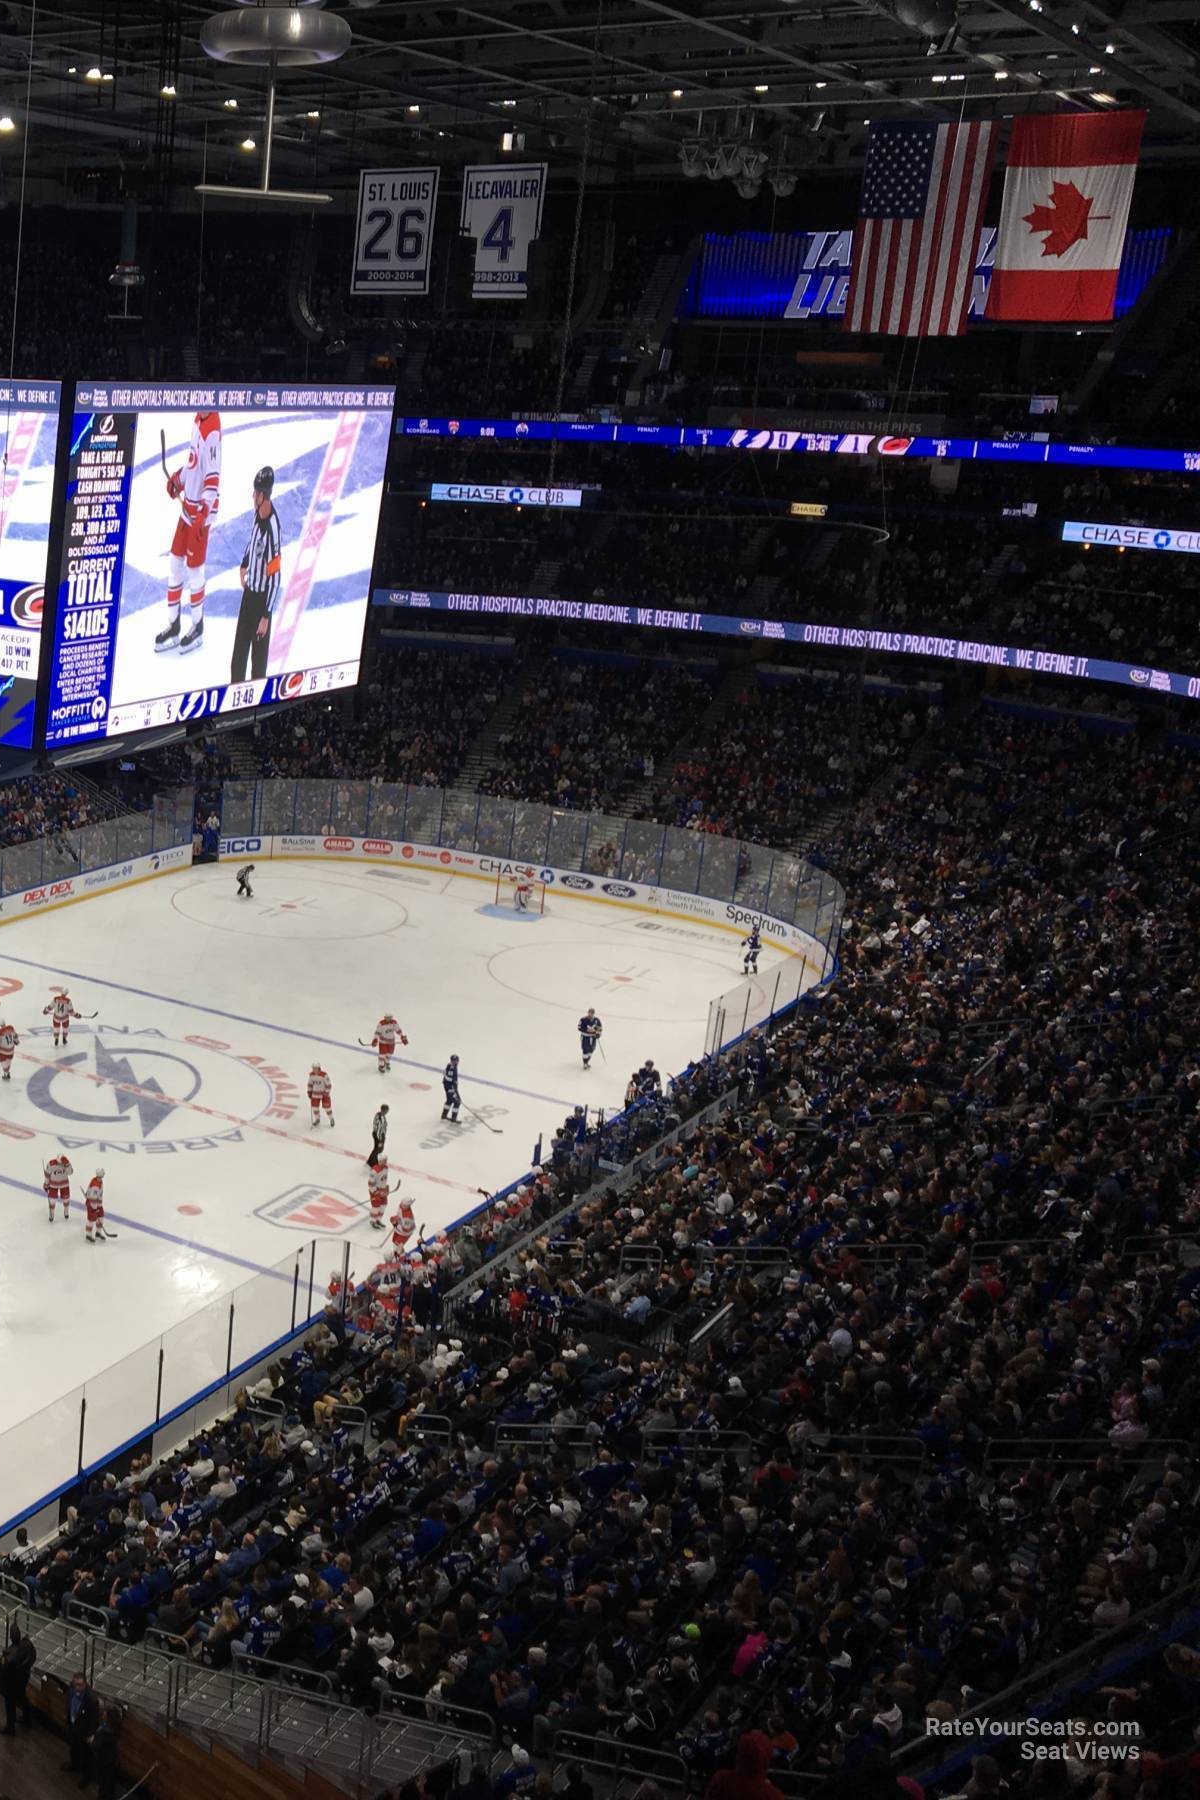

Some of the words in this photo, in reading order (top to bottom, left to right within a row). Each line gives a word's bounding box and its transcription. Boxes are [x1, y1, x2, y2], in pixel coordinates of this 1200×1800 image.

[368, 183, 386, 201] ST.
[391, 182, 430, 200] LOUIS
[468, 178, 539, 200] LECAVALIER
[363, 206, 426, 262] 26
[480, 206, 516, 264] 4
[81, 451, 96, 464] TAKE
[101, 450, 116, 464] SHOT
[936, 445, 946, 456] 15
[76, 466, 106, 480] TONIGHT'S
[78, 480, 93, 494] CASH
[93, 480, 122, 493] DRAWING!
[447, 487, 505, 500] CHASE
[528, 490, 564, 504] CLUB
[792, 505, 820, 514] CHASE
[1082, 526, 1150, 544] CHASE
[68, 556, 116, 574] CURRENT
[68, 571, 113, 606] TOTAL
[448, 594, 478, 611] OTHER
[482, 597, 534, 615] HOSPITALS
[536, 602, 582, 618] PRACTICE
[584, 604, 632, 624] MEDICINE.
[638, 608, 652, 626] WE
[655, 610, 690, 630] DEFINE
[692, 614, 703, 630] IT.
[64, 608, 109, 640] $14105
[6, 646, 13, 656] 10
[14, 646, 32, 658] WON
[804, 625, 840, 645] OTHER
[842, 630, 900, 651] HOSPITALS
[904, 635, 955, 658] PRACTICE
[958, 642, 1010, 666] MEDICINE.
[1017, 649, 1032, 668] WE
[1036, 653, 1074, 674] DEFINE
[1076, 658, 1089, 677] IT.
[310, 676, 316, 690] 15
[232, 690, 254, 708] 13:48
[52, 702, 92, 720] MOFFITT
[326, 840, 353, 848] AMALIE
[23, 888, 47, 904] DEX
[50, 880, 72, 896] DEX
[726, 906, 786, 937] Spectrum
[234, 1055, 299, 1120] AMALIE
[56, 1128, 246, 1155] ARENA
